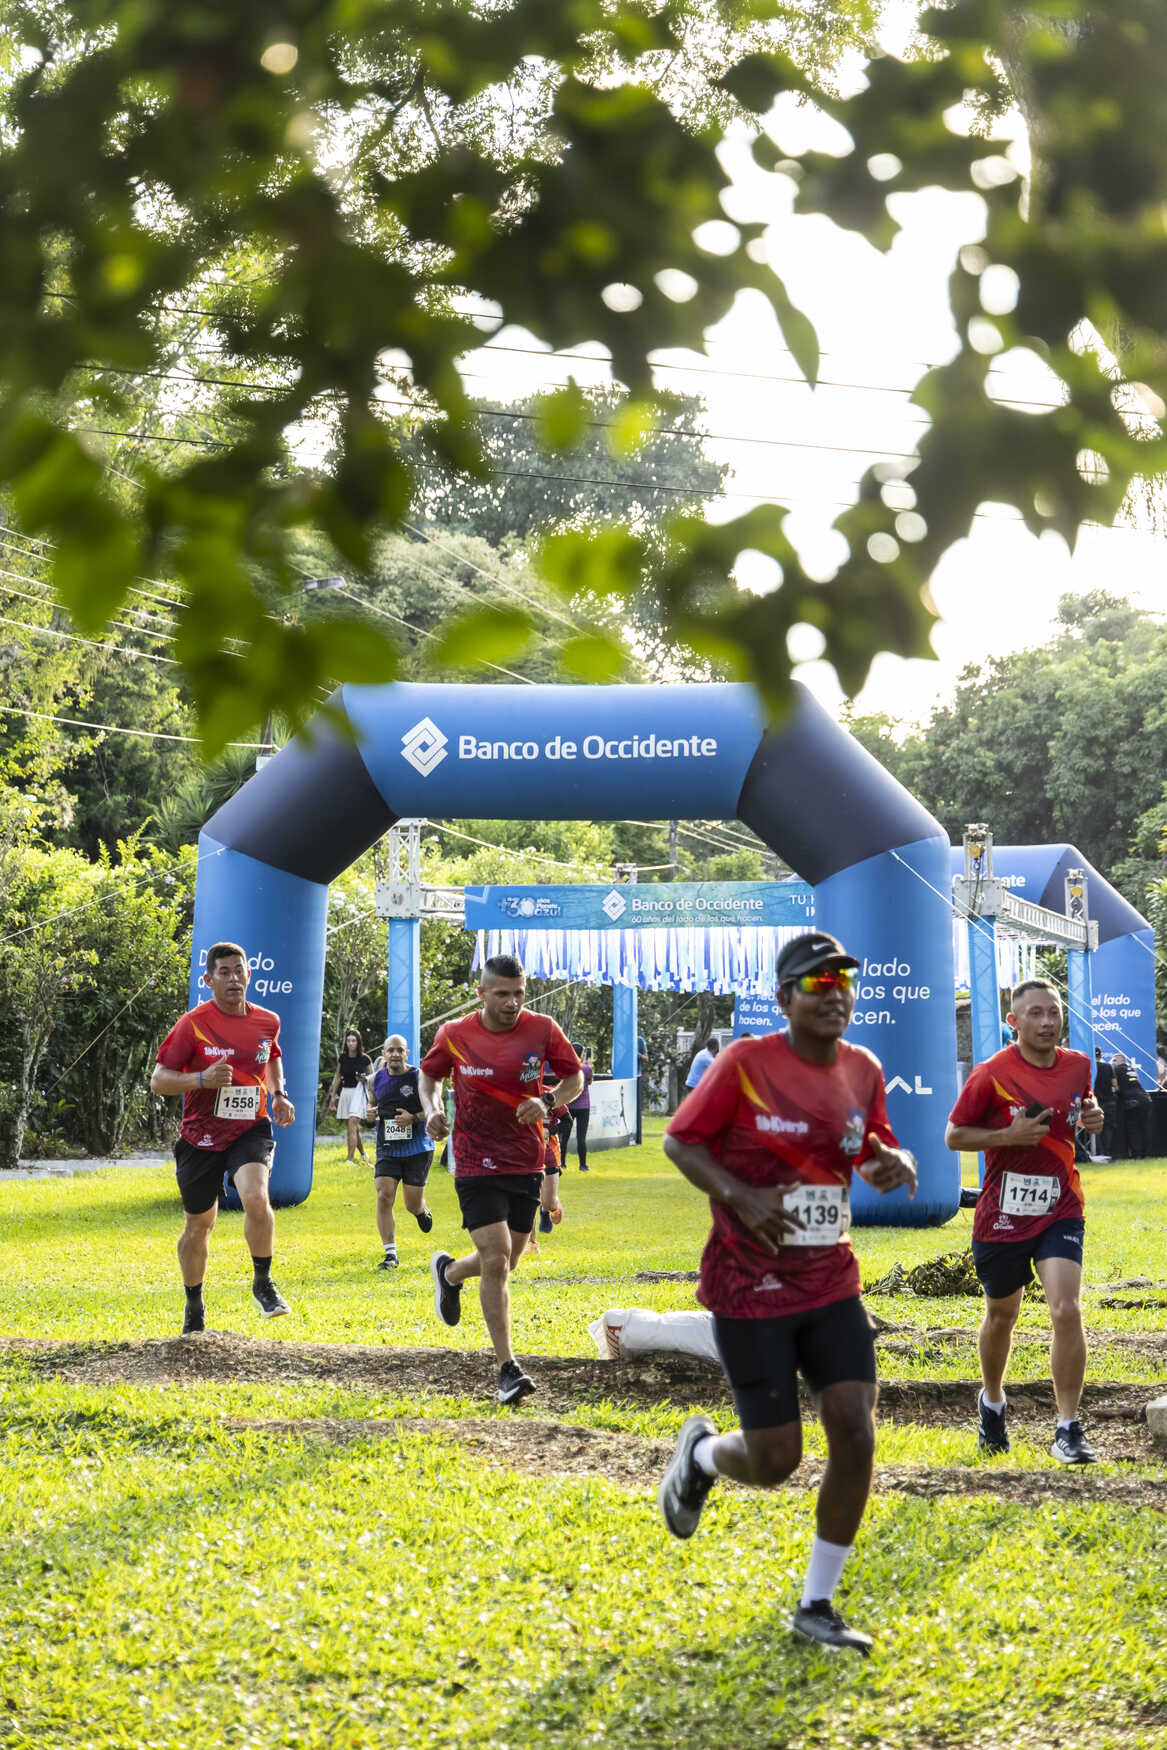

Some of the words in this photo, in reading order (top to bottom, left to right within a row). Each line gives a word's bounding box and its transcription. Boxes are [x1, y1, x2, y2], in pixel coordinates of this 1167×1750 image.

[458, 735, 539, 760] Banco
[544, 736, 577, 760] de
[582, 734, 718, 759] Occidente
[631, 898, 673, 911] Banco
[676, 898, 693, 911] de
[695, 896, 764, 910] Occidente
[789, 894, 807, 905] TU
[631, 915, 641, 923] 60
[862, 957, 911, 977] lado
[254, 979, 293, 998] que
[856, 981, 886, 1000] los
[892, 984, 931, 1004] que
[739, 1001, 751, 1012] de
[752, 1001, 769, 1013] los
[1090, 994, 1102, 1006] el
[1103, 993, 1131, 1006] lado
[738, 1013, 773, 1026] hacen.
[849, 1010, 897, 1026] cen.
[1100, 1006, 1117, 1017] los
[1119, 1008, 1142, 1020] que
[884, 1075, 933, 1095] AL
[223, 1096, 255, 1109] 1558
[1009, 1186, 1049, 1203] 1714
[791, 1204, 839, 1225] 1139
